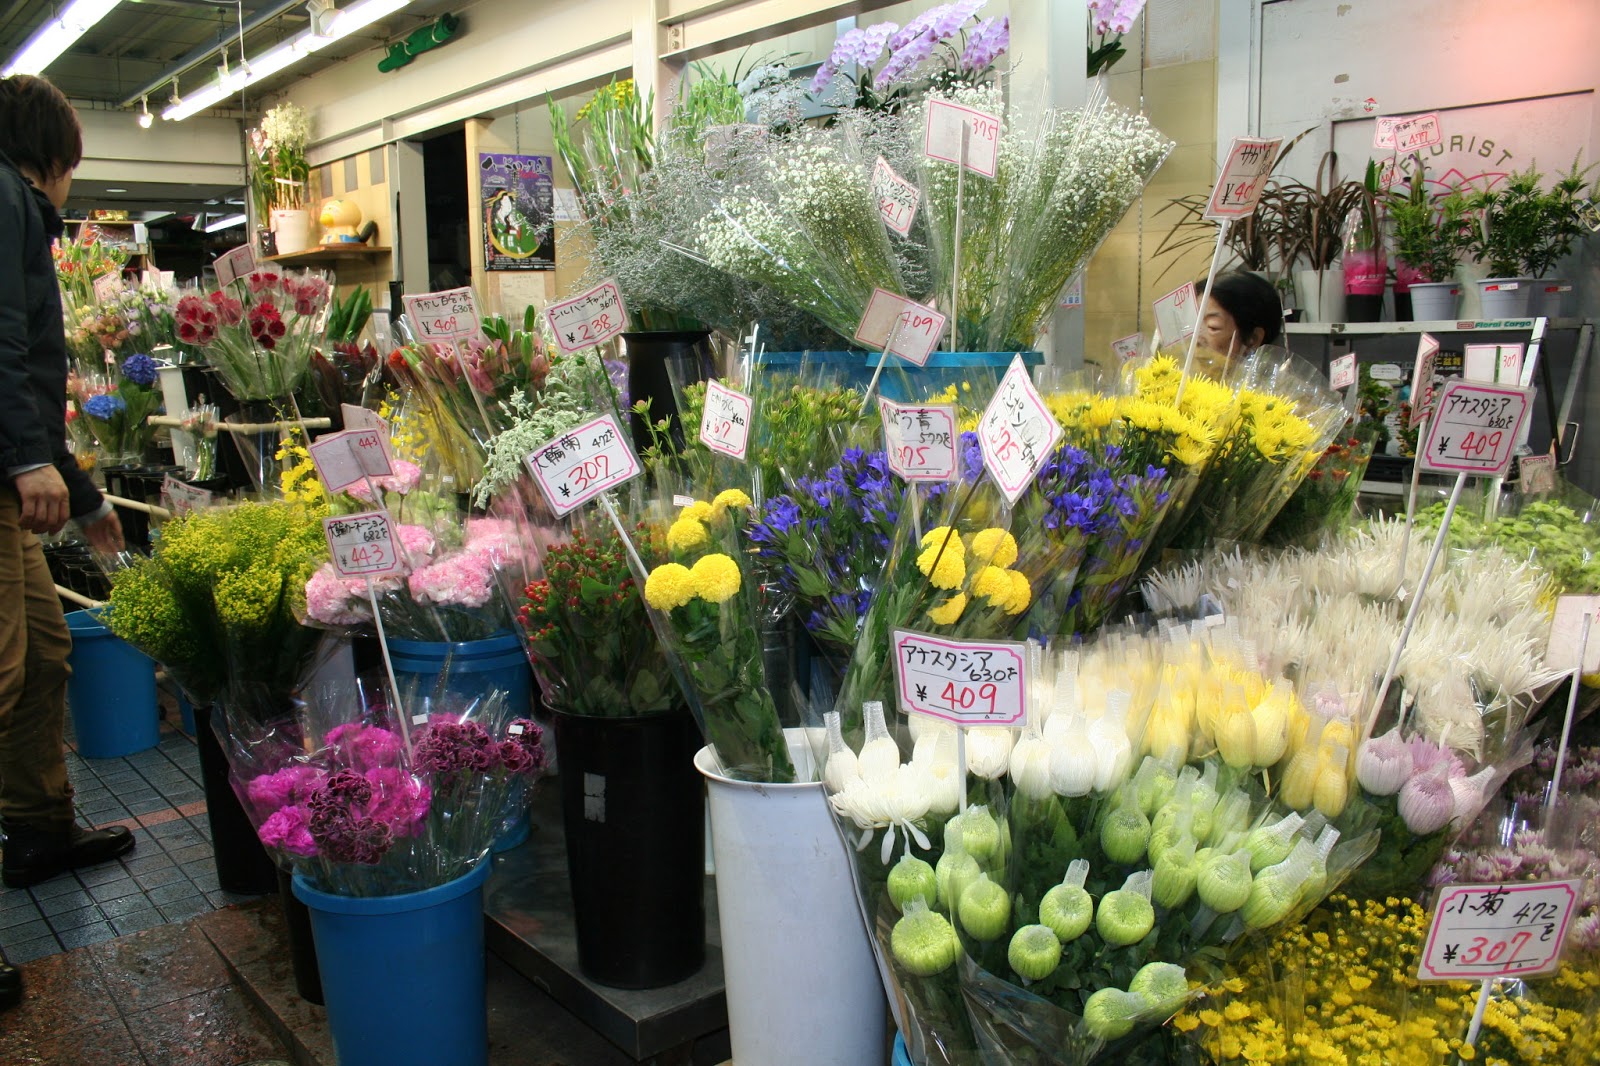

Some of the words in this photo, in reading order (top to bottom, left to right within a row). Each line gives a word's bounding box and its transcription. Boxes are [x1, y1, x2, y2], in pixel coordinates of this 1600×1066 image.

[972, 117, 998, 141] 375
[434, 316, 458, 333] 409
[577, 313, 612, 340] 238
[897, 310, 933, 336] 709
[1475, 320, 1502, 329] Floral
[1503, 320, 1532, 329] Cargo
[1503, 354, 1516, 367] 307
[358, 435, 378, 450] 443
[1460, 431, 1503, 462] 409
[568, 454, 609, 491] 307
[351, 543, 384, 566] 443
[940, 681, 998, 715] 409
[1460, 931, 1534, 972] 307
